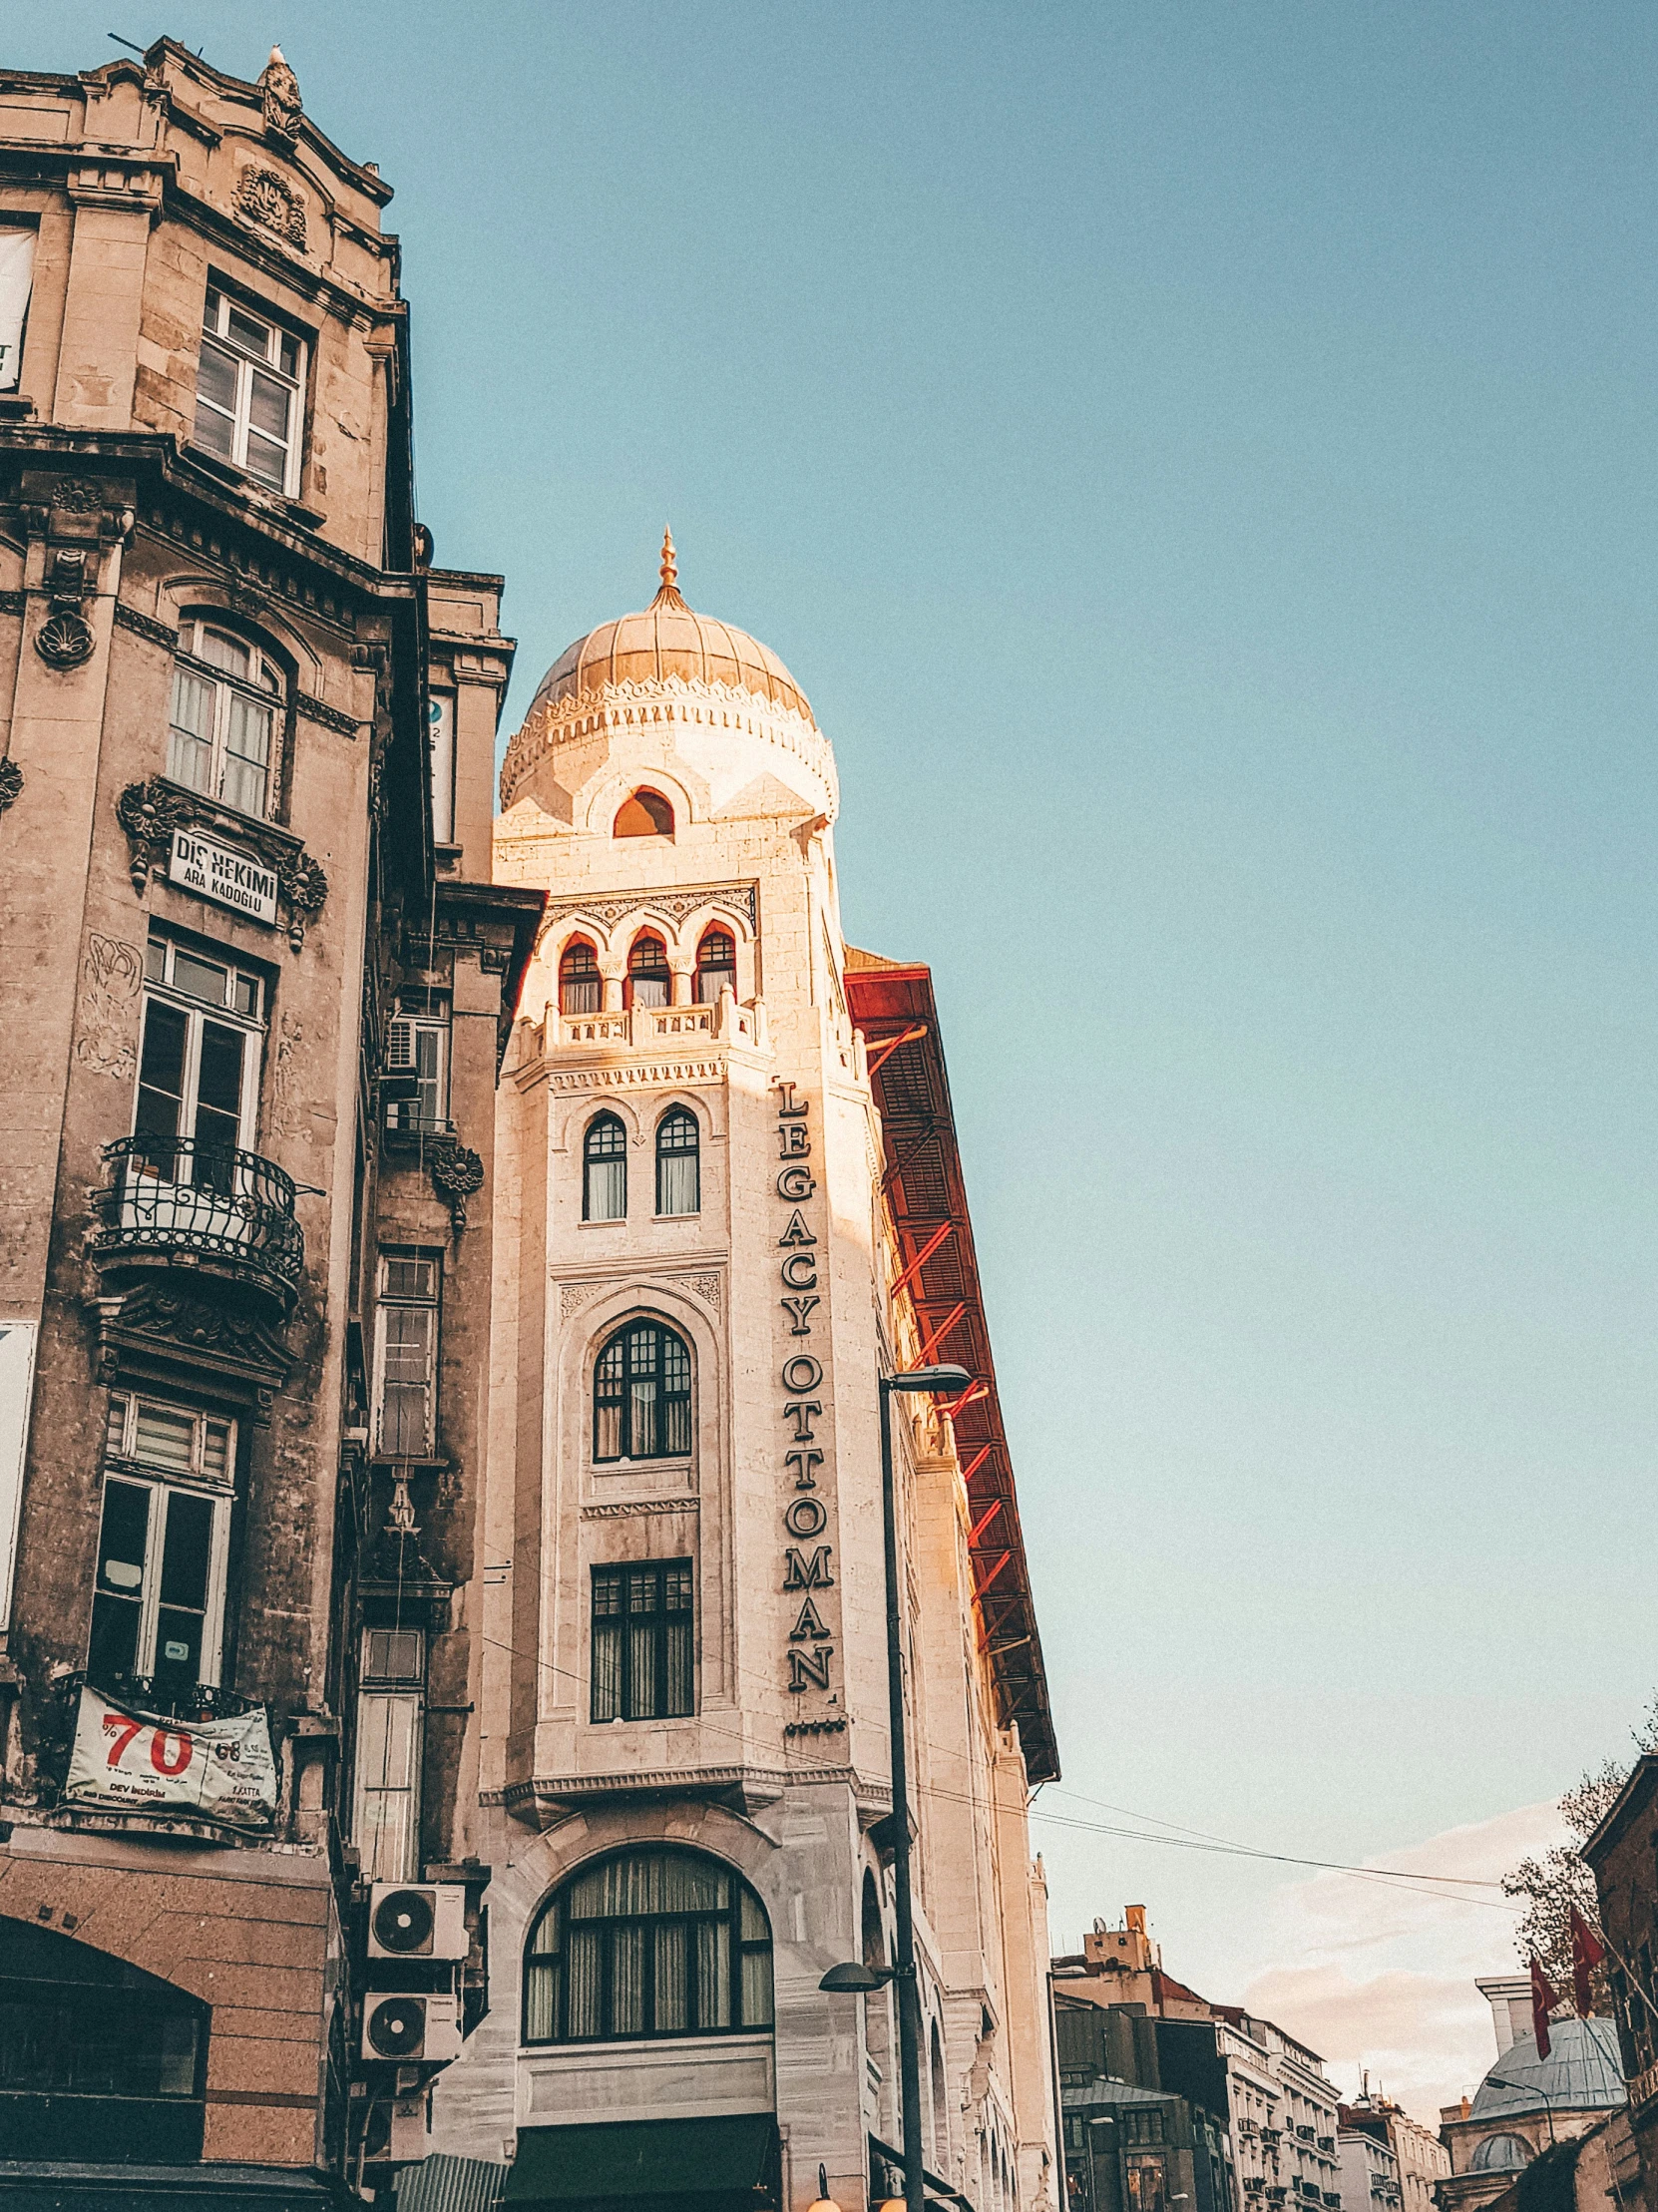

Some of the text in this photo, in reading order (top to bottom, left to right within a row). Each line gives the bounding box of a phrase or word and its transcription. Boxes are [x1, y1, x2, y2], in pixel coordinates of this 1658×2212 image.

[185, 867, 261, 912] ARA KADOĞLU
[211, 851, 274, 900] HEKİMİ
[776, 1082, 820, 1335] LEGACY
[782, 1354, 834, 1692] OTTOMAN
[110, 1783, 130, 1793] DEV
